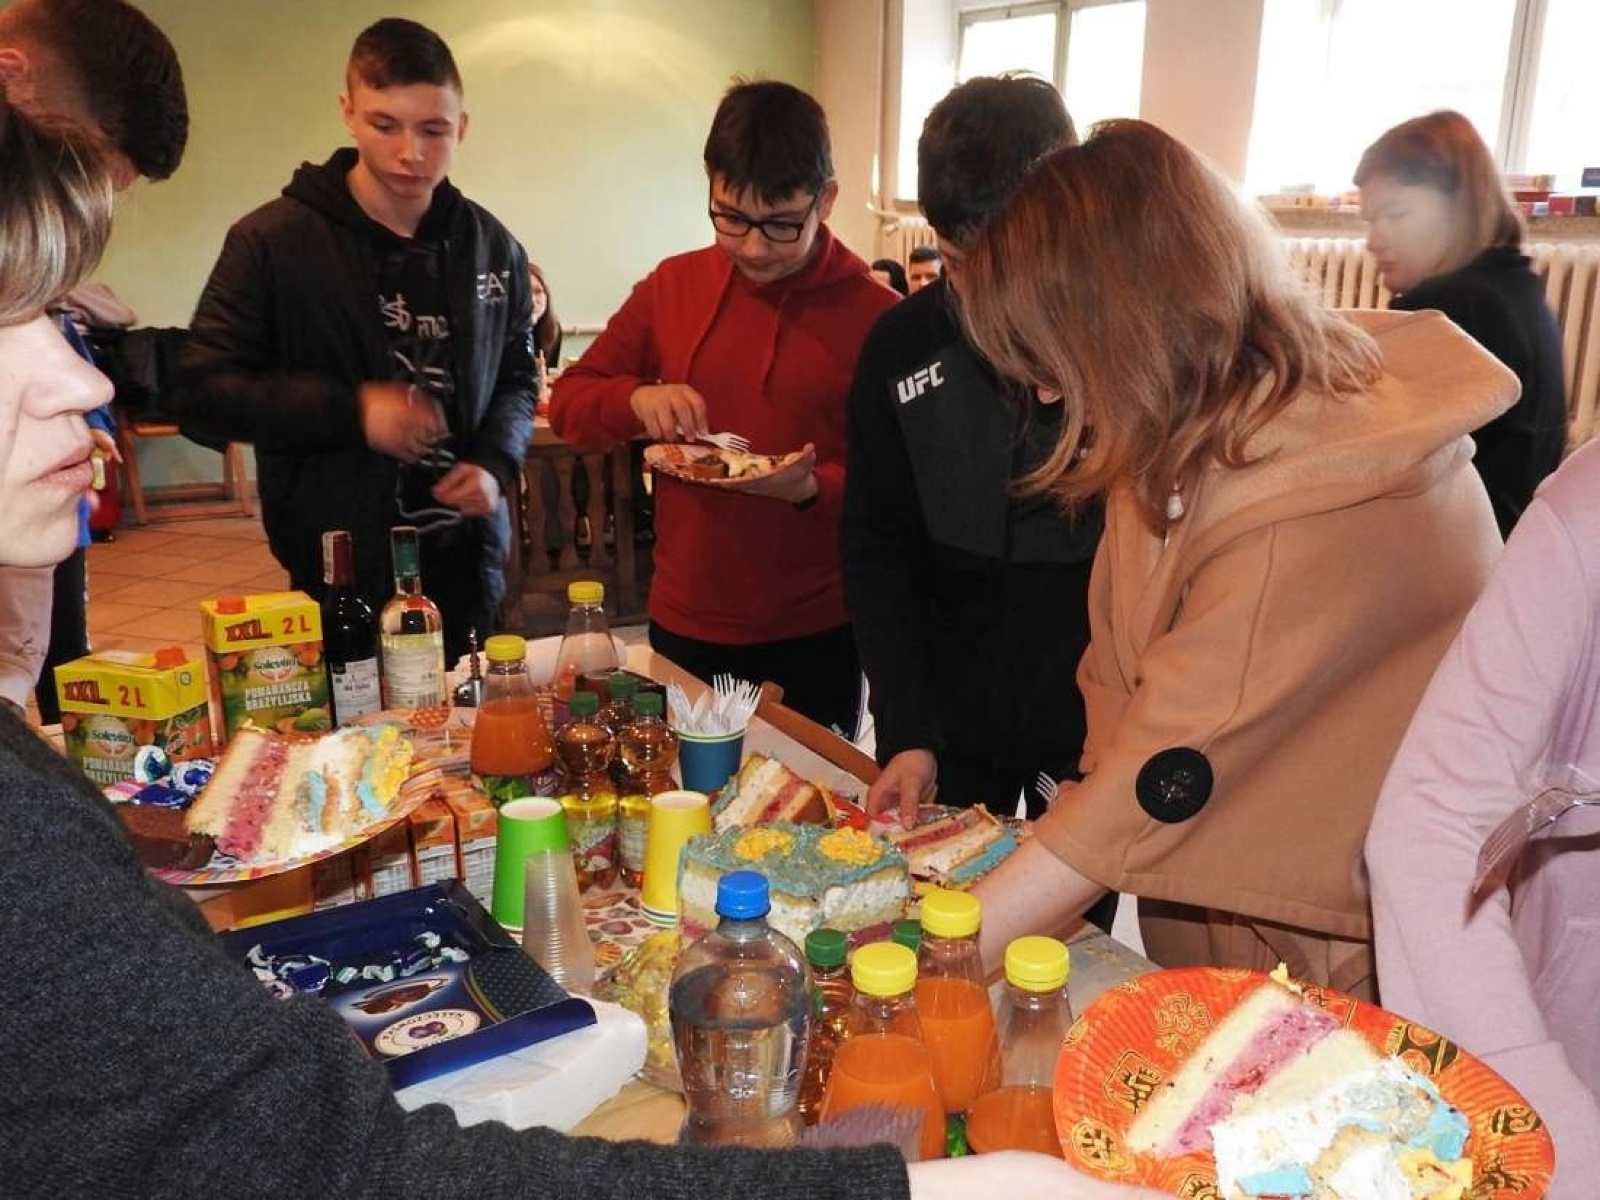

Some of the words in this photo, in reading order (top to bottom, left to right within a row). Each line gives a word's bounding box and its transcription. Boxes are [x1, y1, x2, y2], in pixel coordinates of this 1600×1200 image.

[897, 361, 944, 404] UFC
[225, 619, 272, 641] XXL
[282, 616, 295, 634] 2
[299, 614, 311, 633] L
[64, 680, 110, 704] XXL
[118, 685, 130, 705] 2
[134, 687, 147, 708] L
